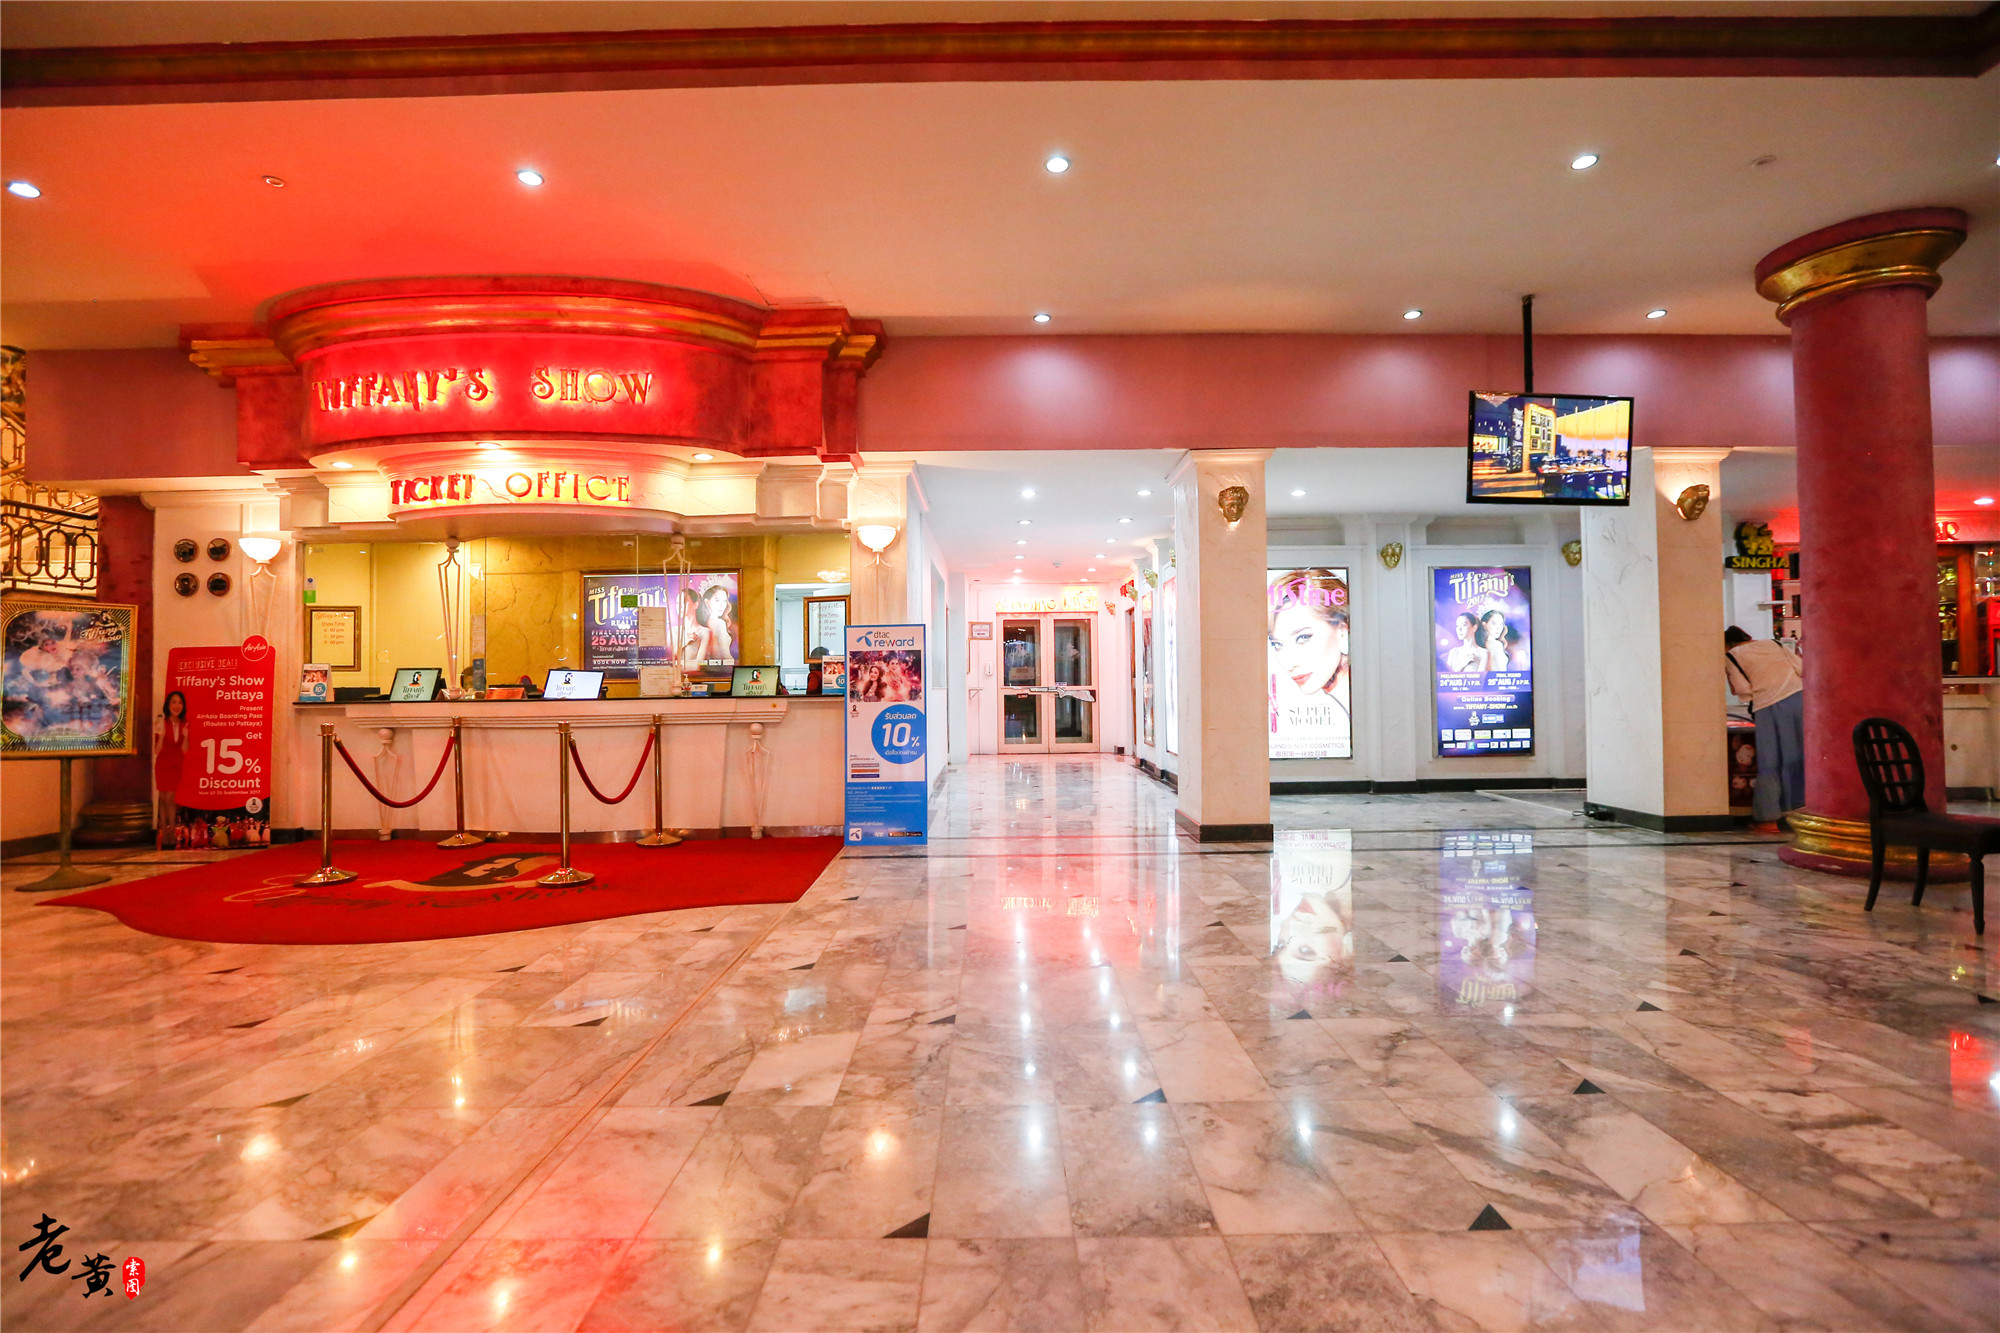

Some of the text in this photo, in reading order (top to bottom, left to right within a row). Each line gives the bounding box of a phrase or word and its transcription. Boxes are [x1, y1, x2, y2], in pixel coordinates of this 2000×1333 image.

[312, 366, 652, 412] TIFFANY'S SHOW
[390, 470, 631, 505] TICKET OFFICE
[1732, 556, 1789, 568] SINGHA
[588, 586, 606, 595] MISS
[1449, 571, 1515, 604] Tiffany's
[611, 619, 638, 627] REALIT
[608, 634, 638, 646] AUG
[874, 631, 890, 639] dtac
[244, 642, 267, 652] AirAsia
[874, 636, 915, 648] reward
[180, 660, 216, 670] EXCLUSIVE
[175, 675, 265, 689] Tiffany's Show
[216, 689, 264, 702] Pattaya
[884, 711, 917, 720] รับส่วนลด
[1289, 706, 1331, 716] SUPER
[236, 720, 263, 728] Pattaya)
[1289, 716, 1336, 726] MODEL
[245, 731, 262, 740] Get
[199, 777, 261, 789] Discount
